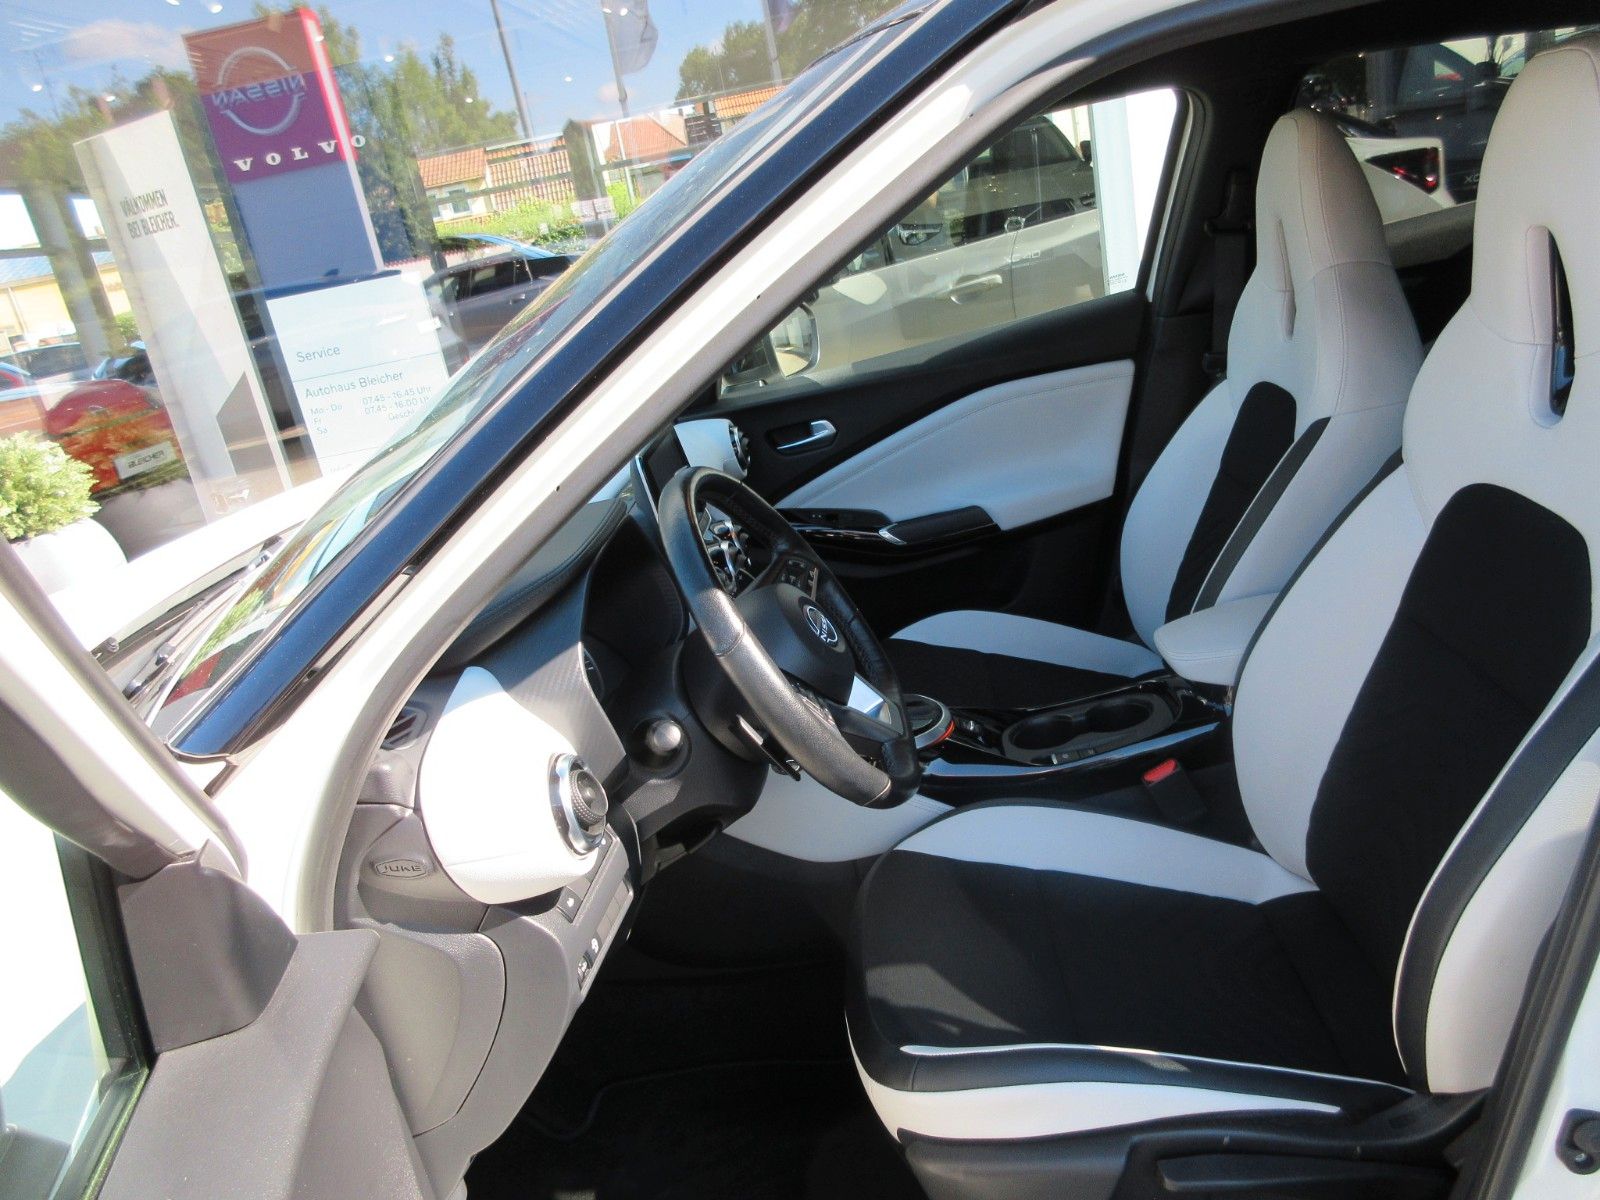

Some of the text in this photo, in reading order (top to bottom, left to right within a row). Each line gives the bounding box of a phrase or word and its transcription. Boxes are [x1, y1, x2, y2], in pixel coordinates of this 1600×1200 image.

[233, 134, 366, 172] VOLVO
[296, 345, 341, 363] Service
[305, 371, 404, 399] Autohaus Bleicher
[380, 864, 423, 874] JUKE
